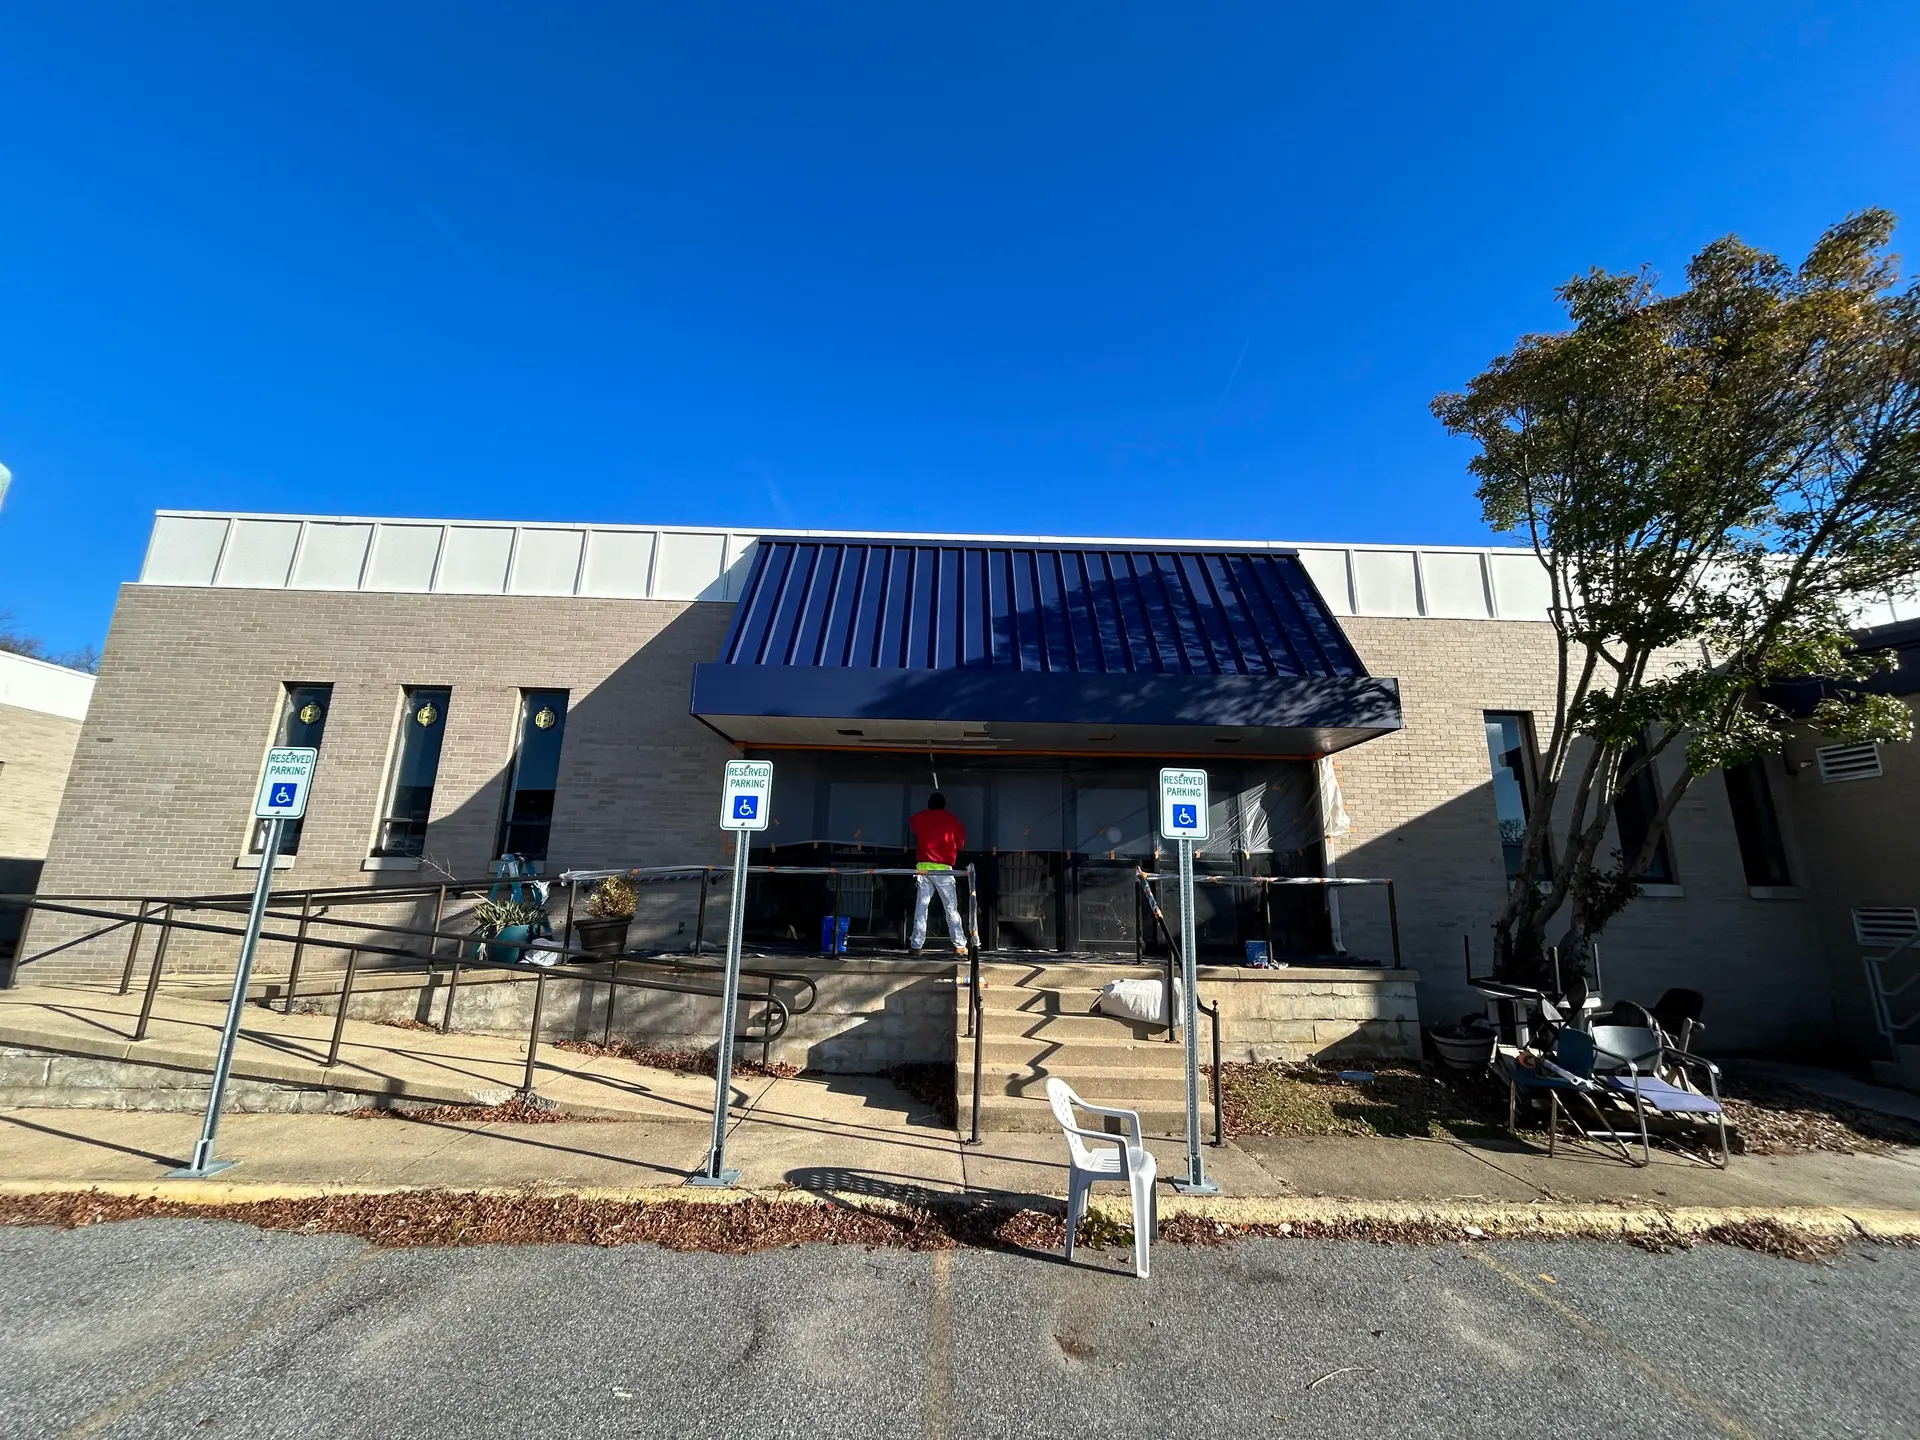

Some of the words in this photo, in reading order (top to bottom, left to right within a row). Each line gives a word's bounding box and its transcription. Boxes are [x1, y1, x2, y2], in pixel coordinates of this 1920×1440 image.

[270, 754, 311, 763] RESERVED
[270, 766, 306, 775] PARKING
[729, 767, 768, 776] RESERVED
[730, 779, 765, 788] PARKING
[1164, 776, 1203, 785] RESERVED
[1167, 787, 1201, 797] PARKING
